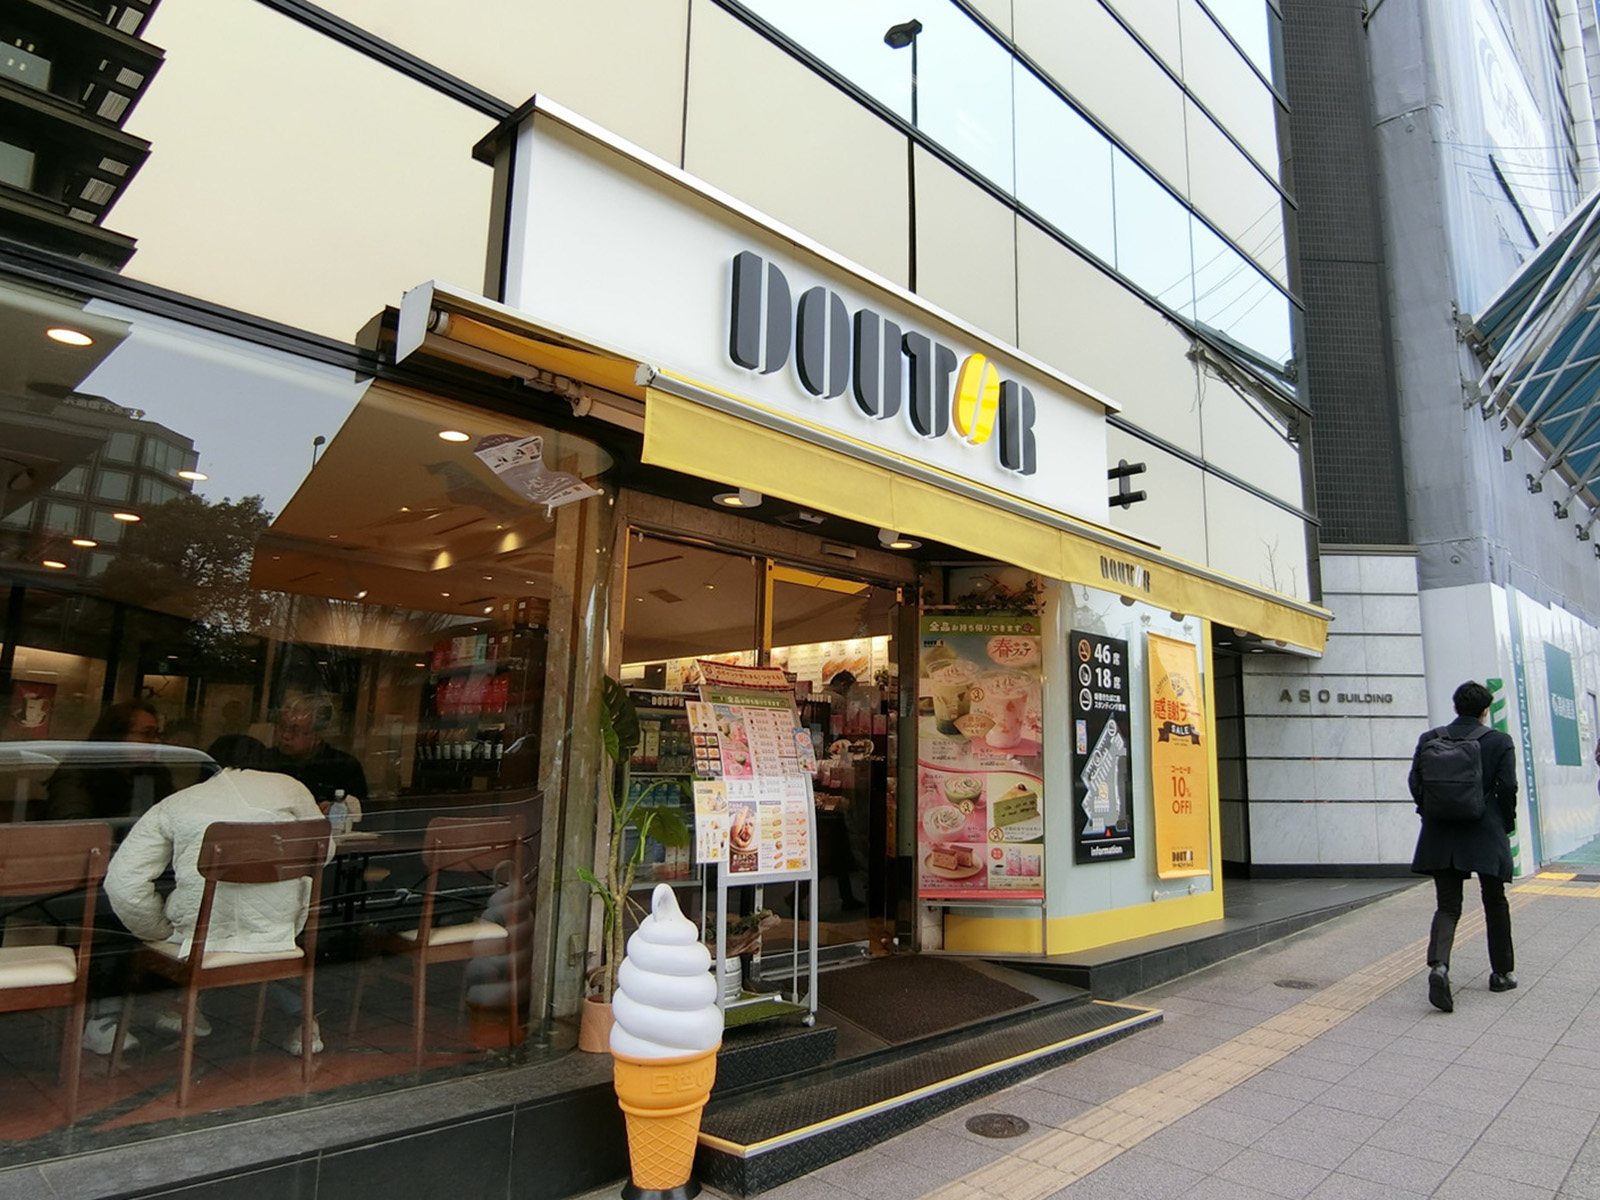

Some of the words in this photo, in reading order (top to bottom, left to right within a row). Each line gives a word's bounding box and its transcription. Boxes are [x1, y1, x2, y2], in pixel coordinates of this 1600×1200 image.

[730, 250, 1037, 475] DOUTOR
[1100, 555, 1150, 593] DOUTOR
[929, 621, 1021, 632] 全品お持ち帰りできます
[1337, 693, 1393, 703] BUILDING
[1153, 697, 1200, 721] 感謝デー
[1171, 724, 1189, 735] SALE
[1172, 800, 1192, 814] OFF!
